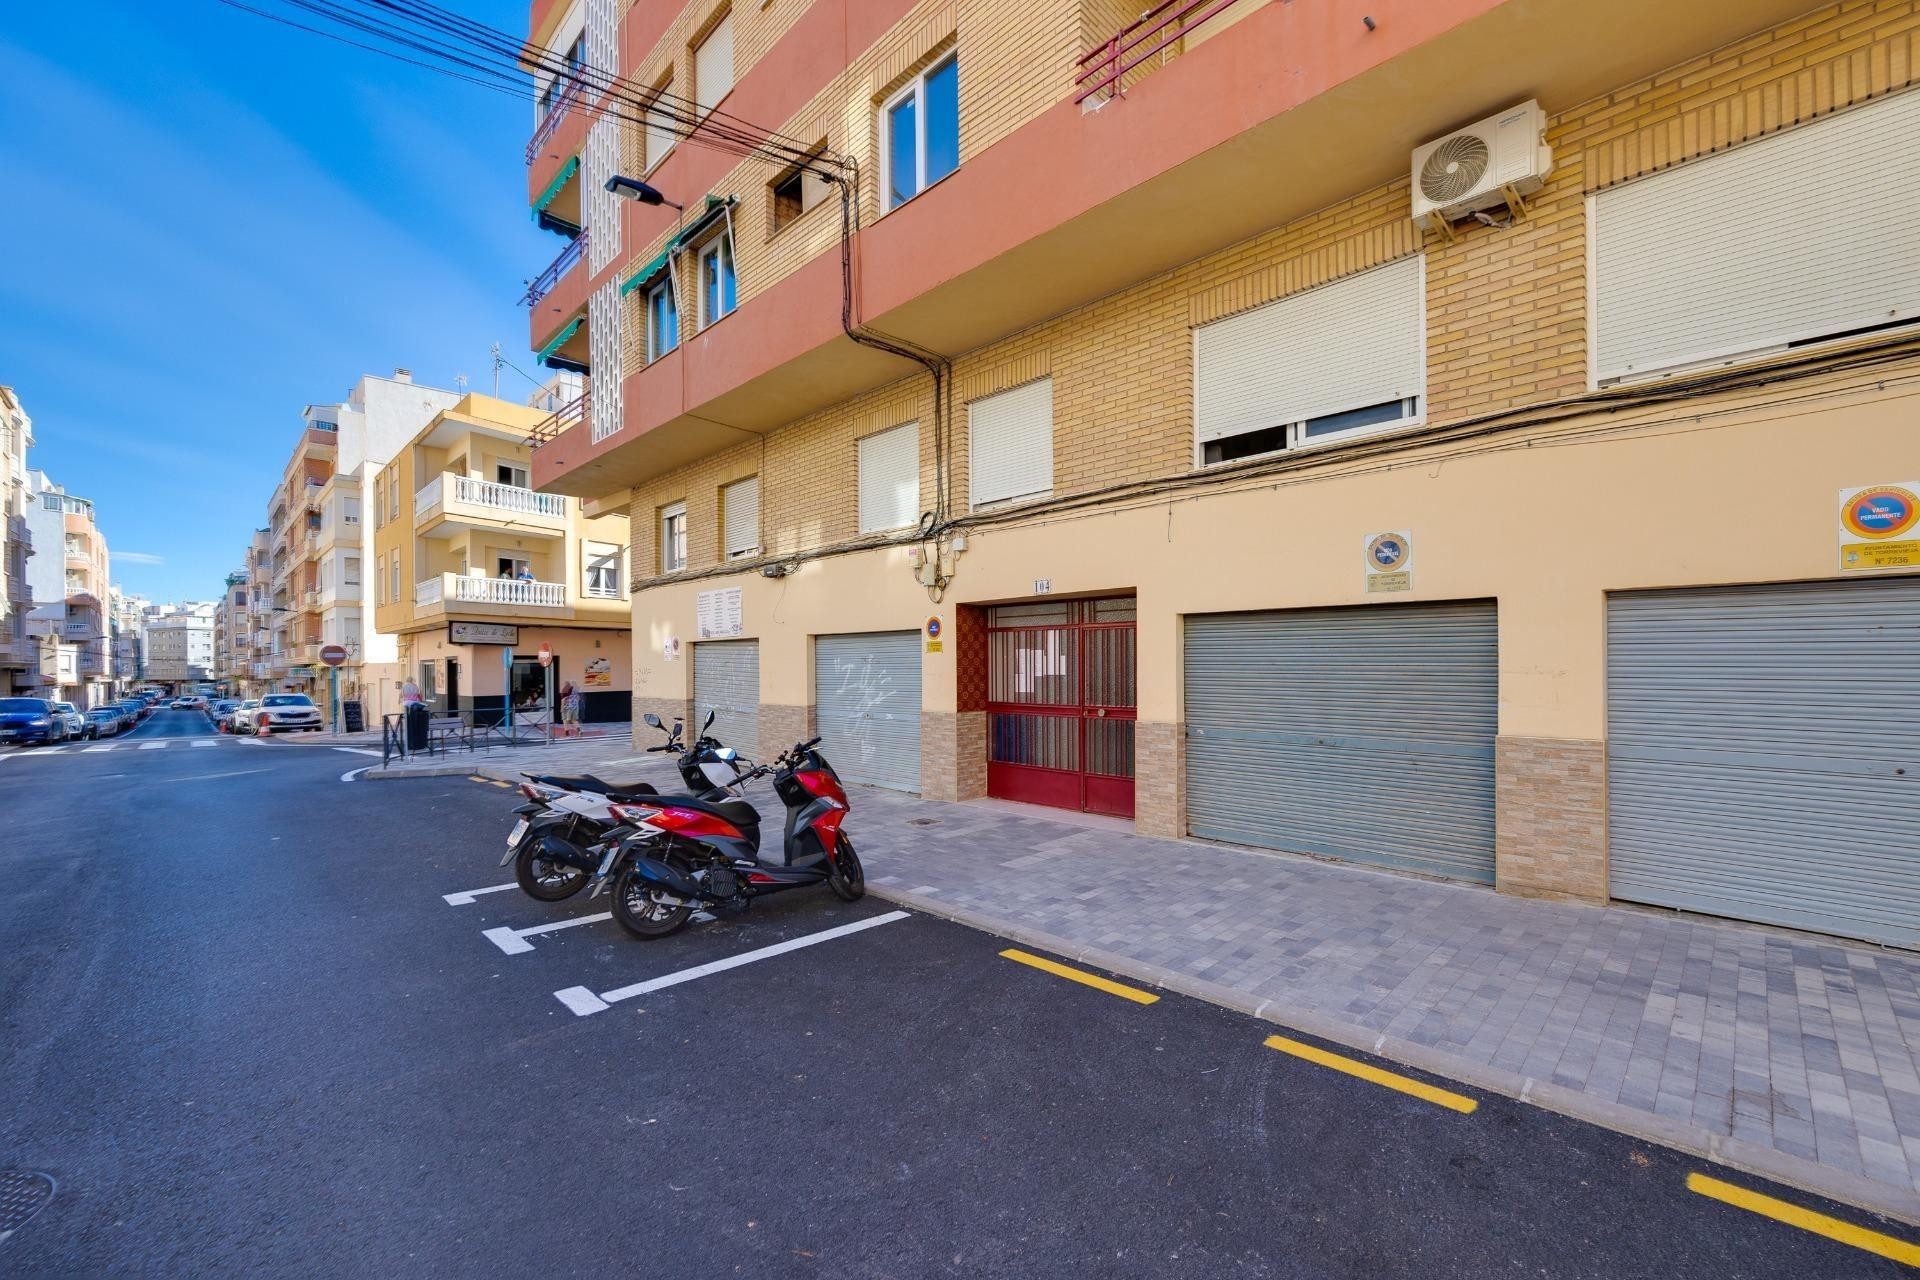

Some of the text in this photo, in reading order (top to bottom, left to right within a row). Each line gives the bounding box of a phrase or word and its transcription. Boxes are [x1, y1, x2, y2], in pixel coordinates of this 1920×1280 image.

[1860, 512, 1902, 520] PERMANENTE
[1887, 556, 1909, 565] 7236
[1034, 580, 1049, 592] 104
